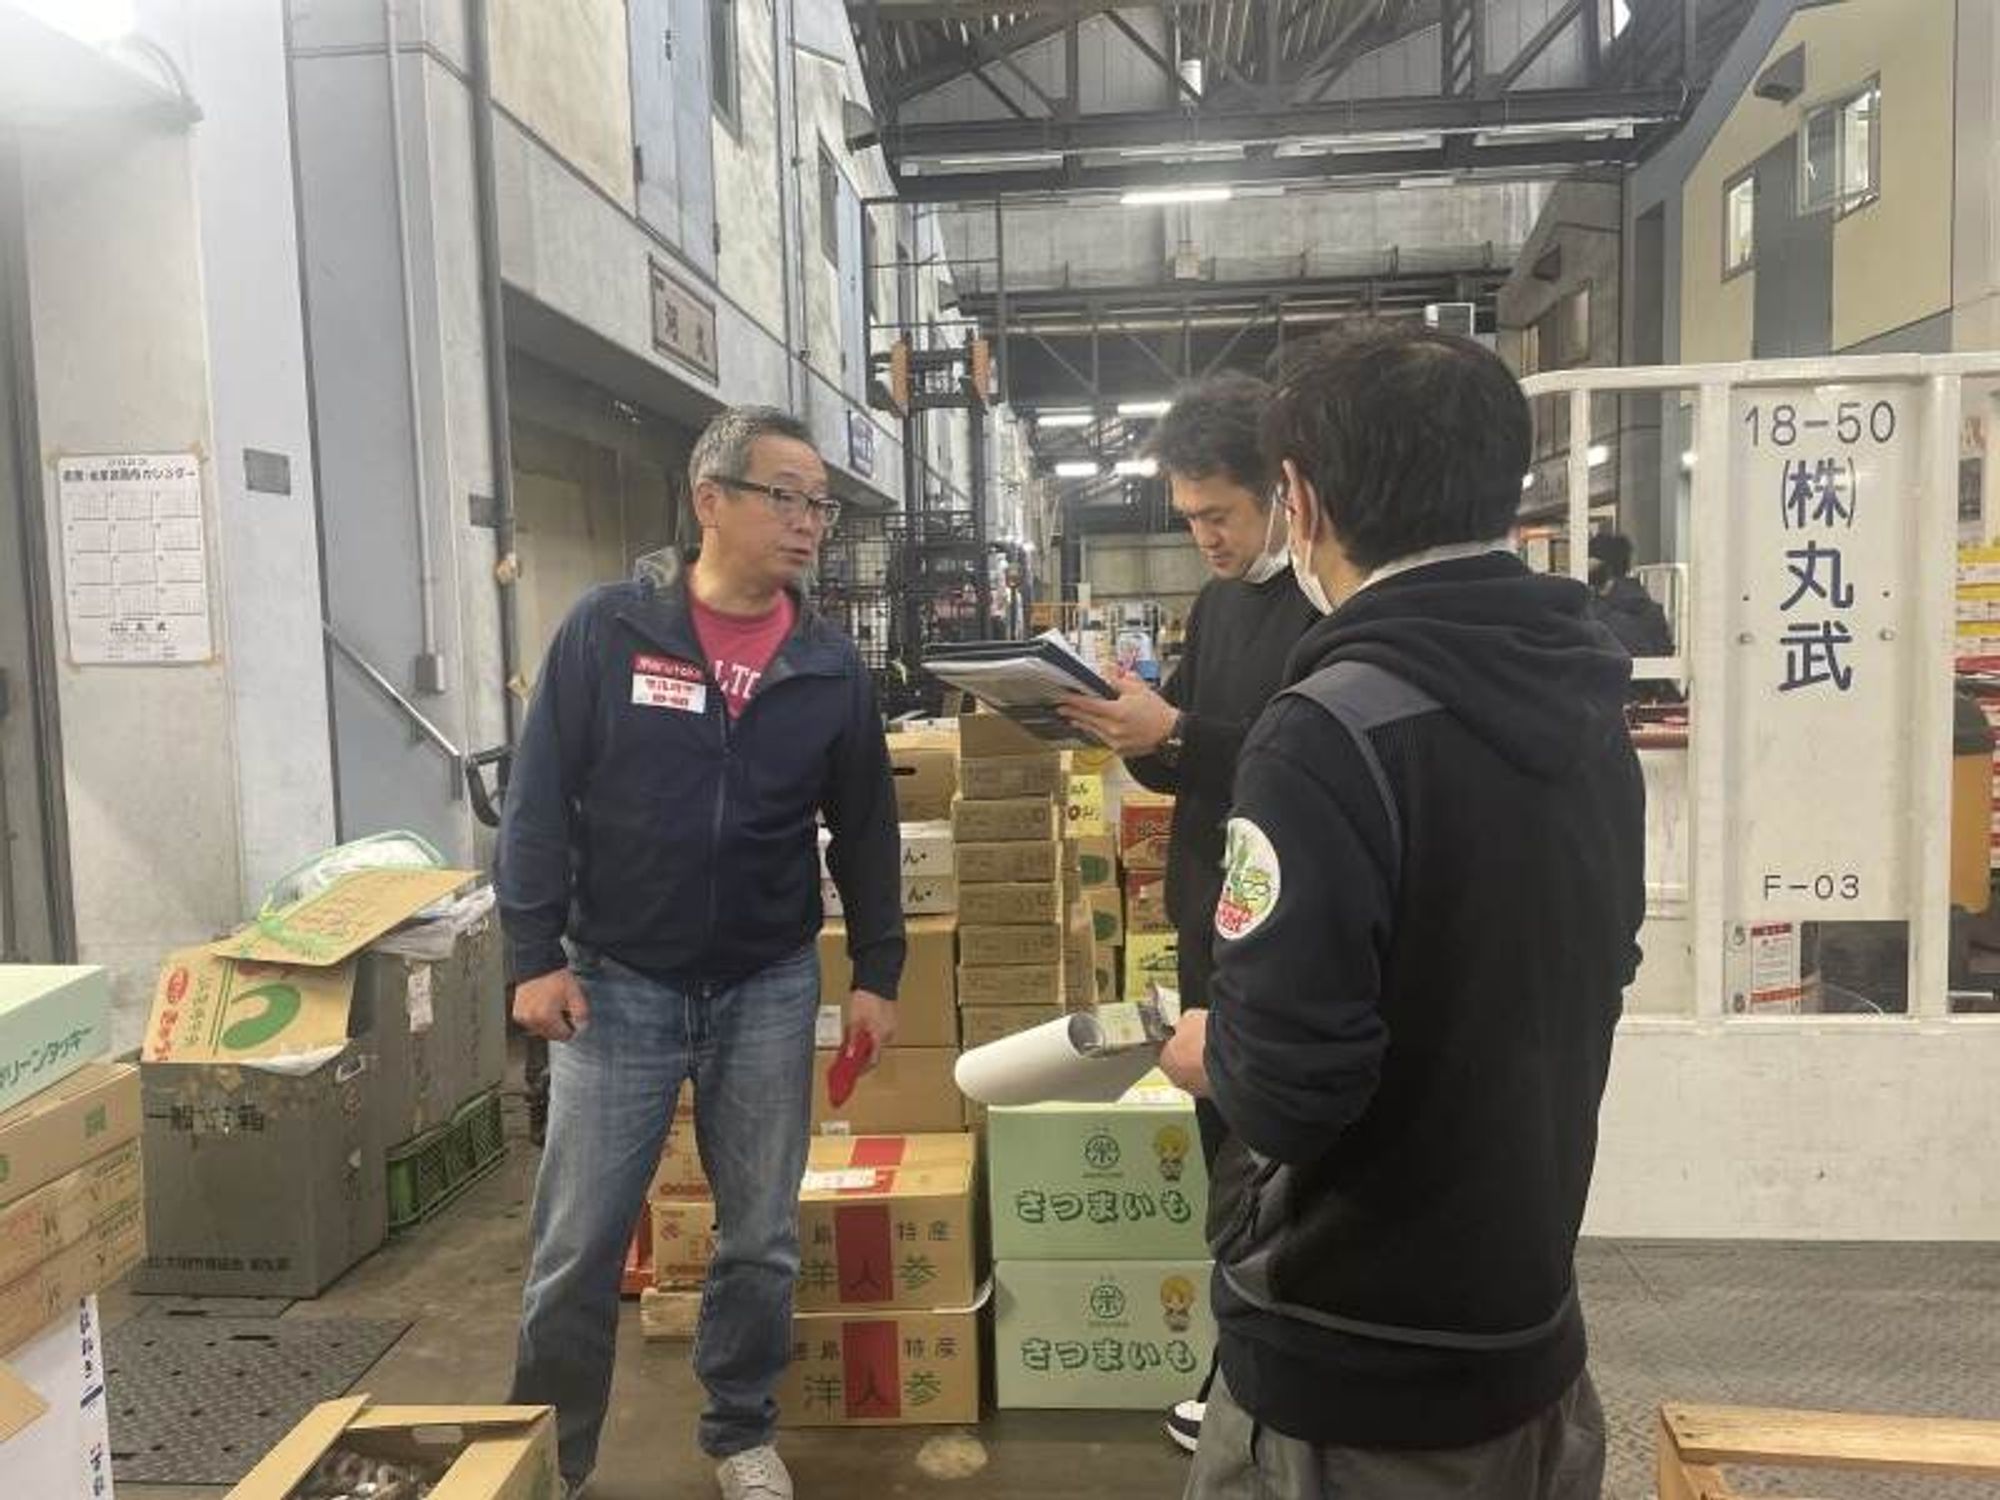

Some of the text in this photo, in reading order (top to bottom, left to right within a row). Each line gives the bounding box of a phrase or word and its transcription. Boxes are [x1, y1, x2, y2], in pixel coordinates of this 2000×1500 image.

[1745, 401, 1896, 446] 18-50
[1764, 874, 1859, 901] F-03
[1017, 1190, 1192, 1224] さつまいも
[1022, 1338, 1197, 1373] さつまいも
